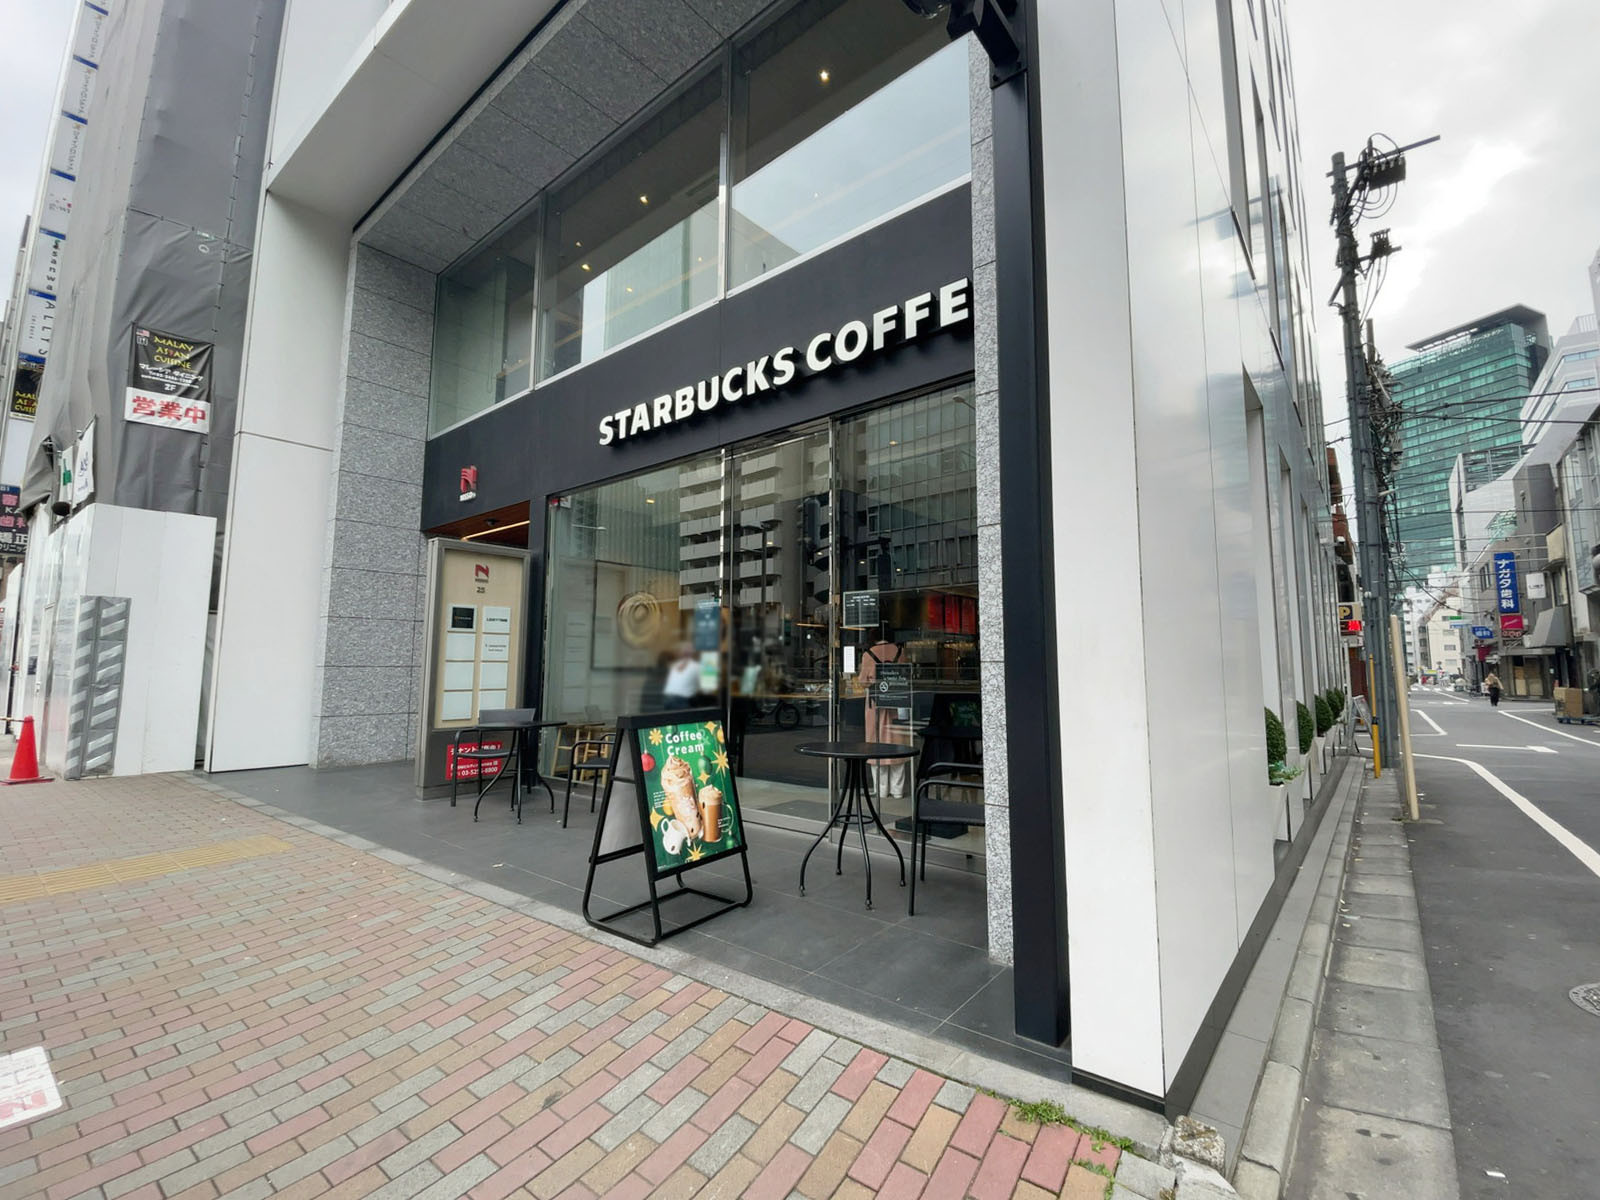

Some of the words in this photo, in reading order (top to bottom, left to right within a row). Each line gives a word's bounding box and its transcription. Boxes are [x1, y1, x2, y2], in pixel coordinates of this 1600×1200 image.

[153, 336, 194, 352] MALAY
[154, 355, 192, 369] CUISINE
[599, 346, 796, 447] STARBUCKS
[805, 277, 969, 372] COFFEE
[164, 383, 177, 391] 2F
[132, 395, 206, 424] 営業中
[1497, 559, 1514, 609] ナガタ歯科
[665, 731, 702, 744] Coffee
[667, 743, 705, 756] Cream
